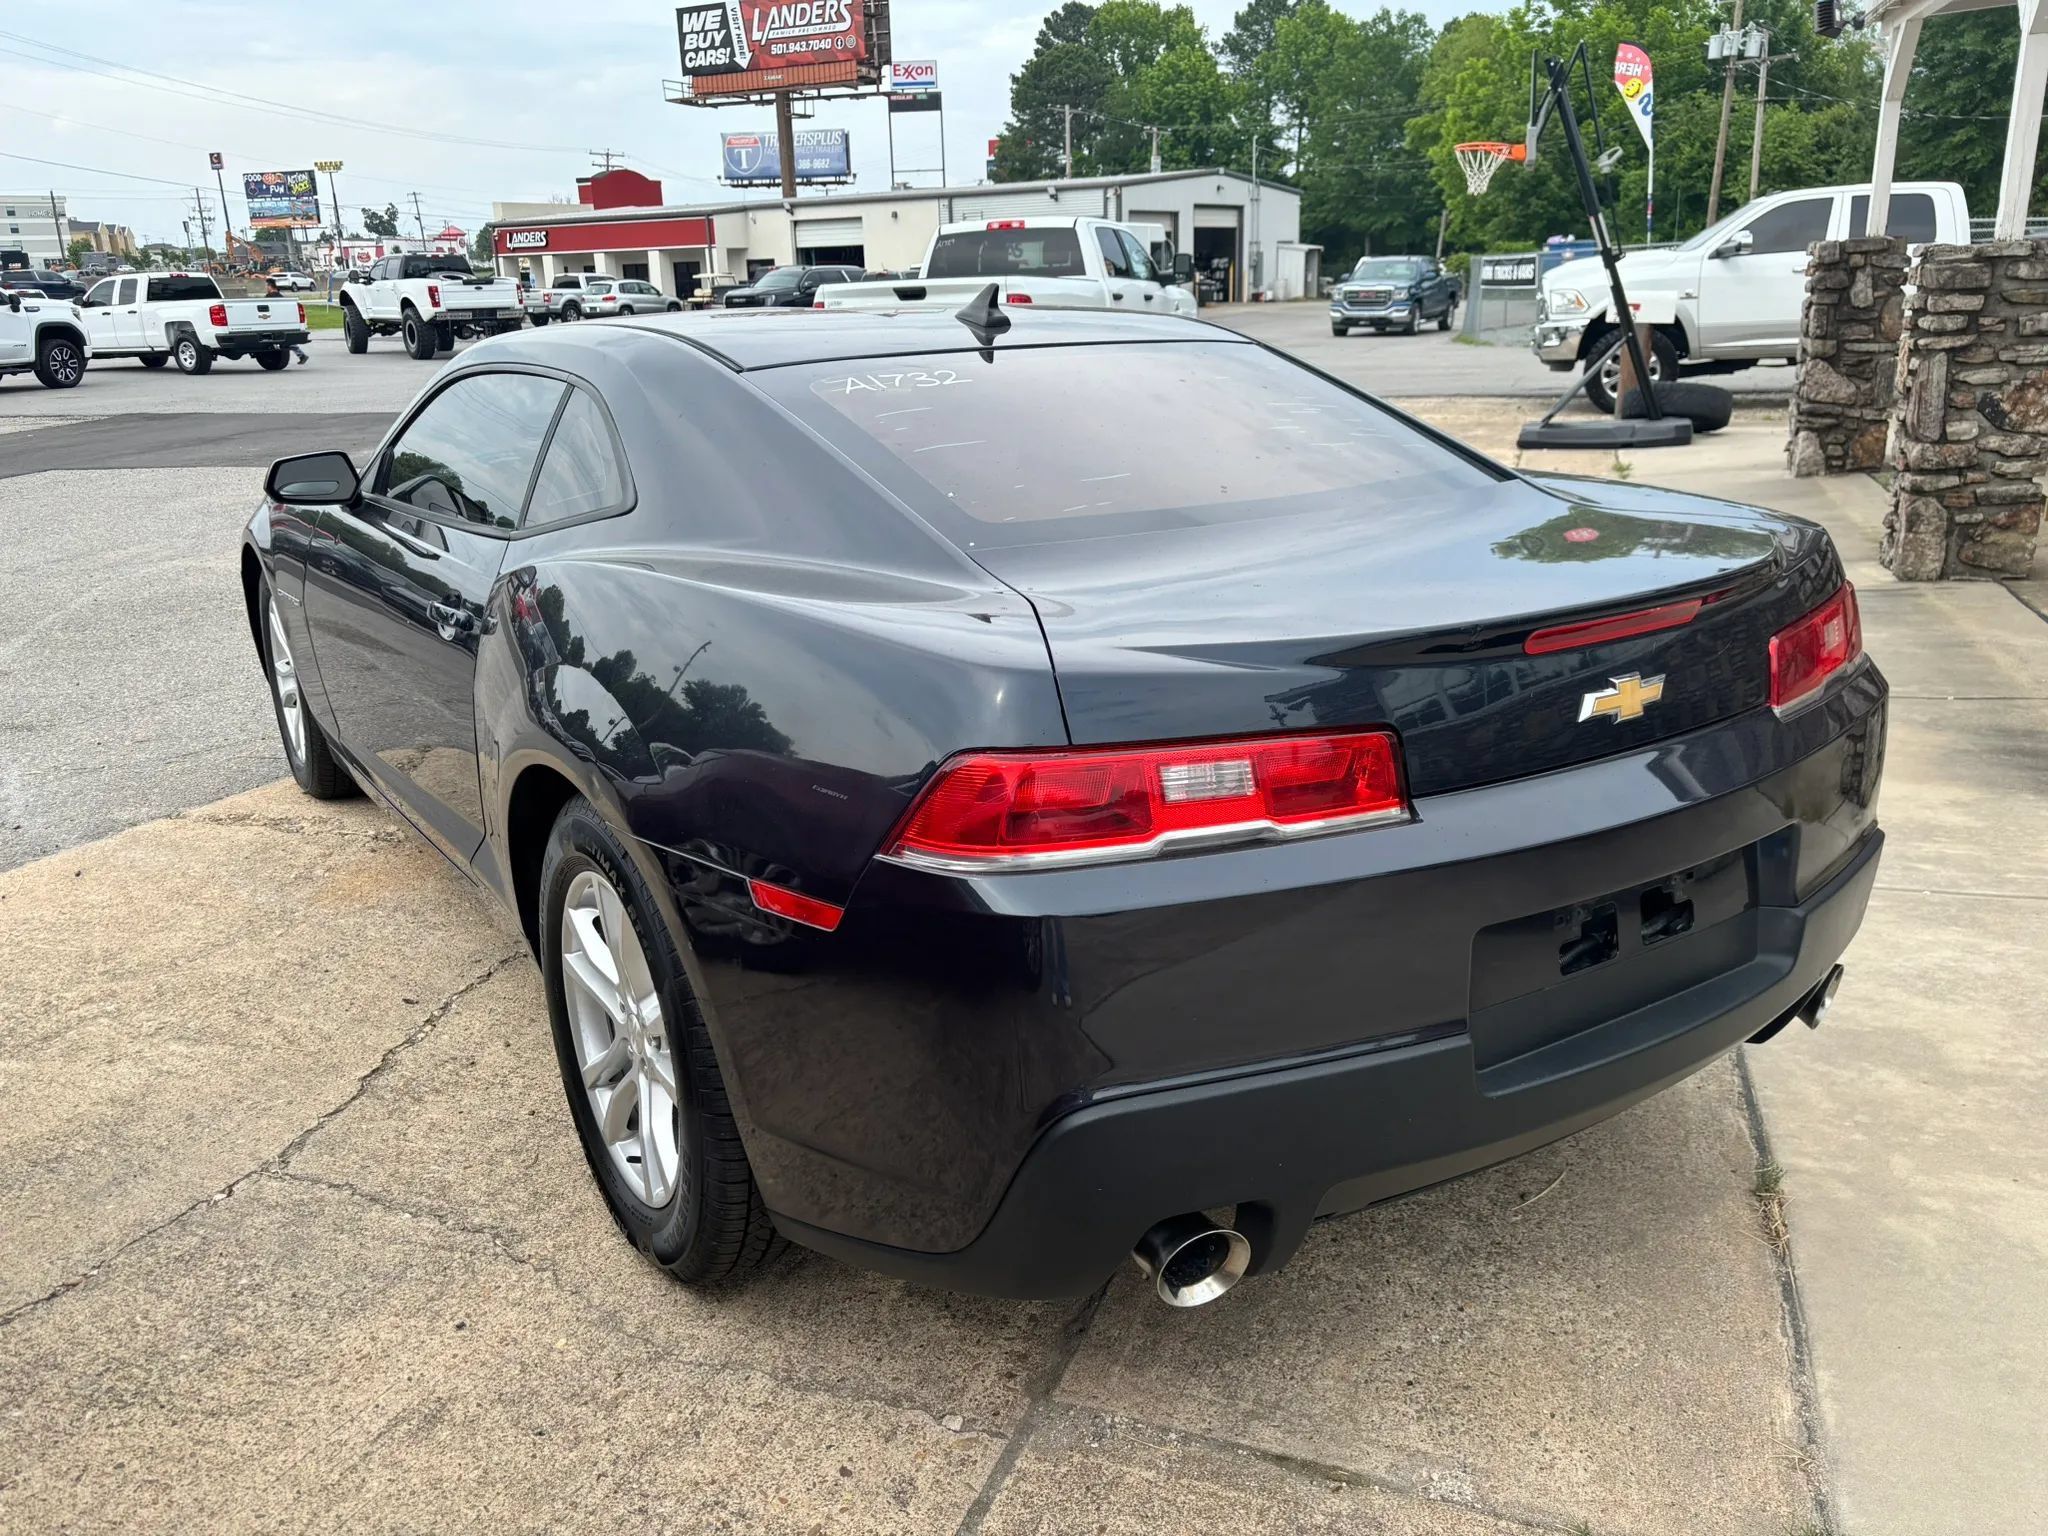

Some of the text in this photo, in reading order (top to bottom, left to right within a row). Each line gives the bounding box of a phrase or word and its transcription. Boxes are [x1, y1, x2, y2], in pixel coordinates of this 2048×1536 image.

[682, 9, 723, 33] WE
[752, 0, 852, 46] LANDERS
[684, 30, 727, 50] BUY
[730, 7, 747, 60] VISIT HERE!
[771, 39, 832, 55] 501.943.7040
[685, 47, 731, 68] CARS!
[893, 64, 934, 80] Exxon
[763, 131, 842, 147] TRERSPLUS
[244, 174, 262, 182] FOOD
[270, 184, 284, 194] FUN
[507, 231, 546, 250] LANDERS
[845, 370, 973, 394] A1732
